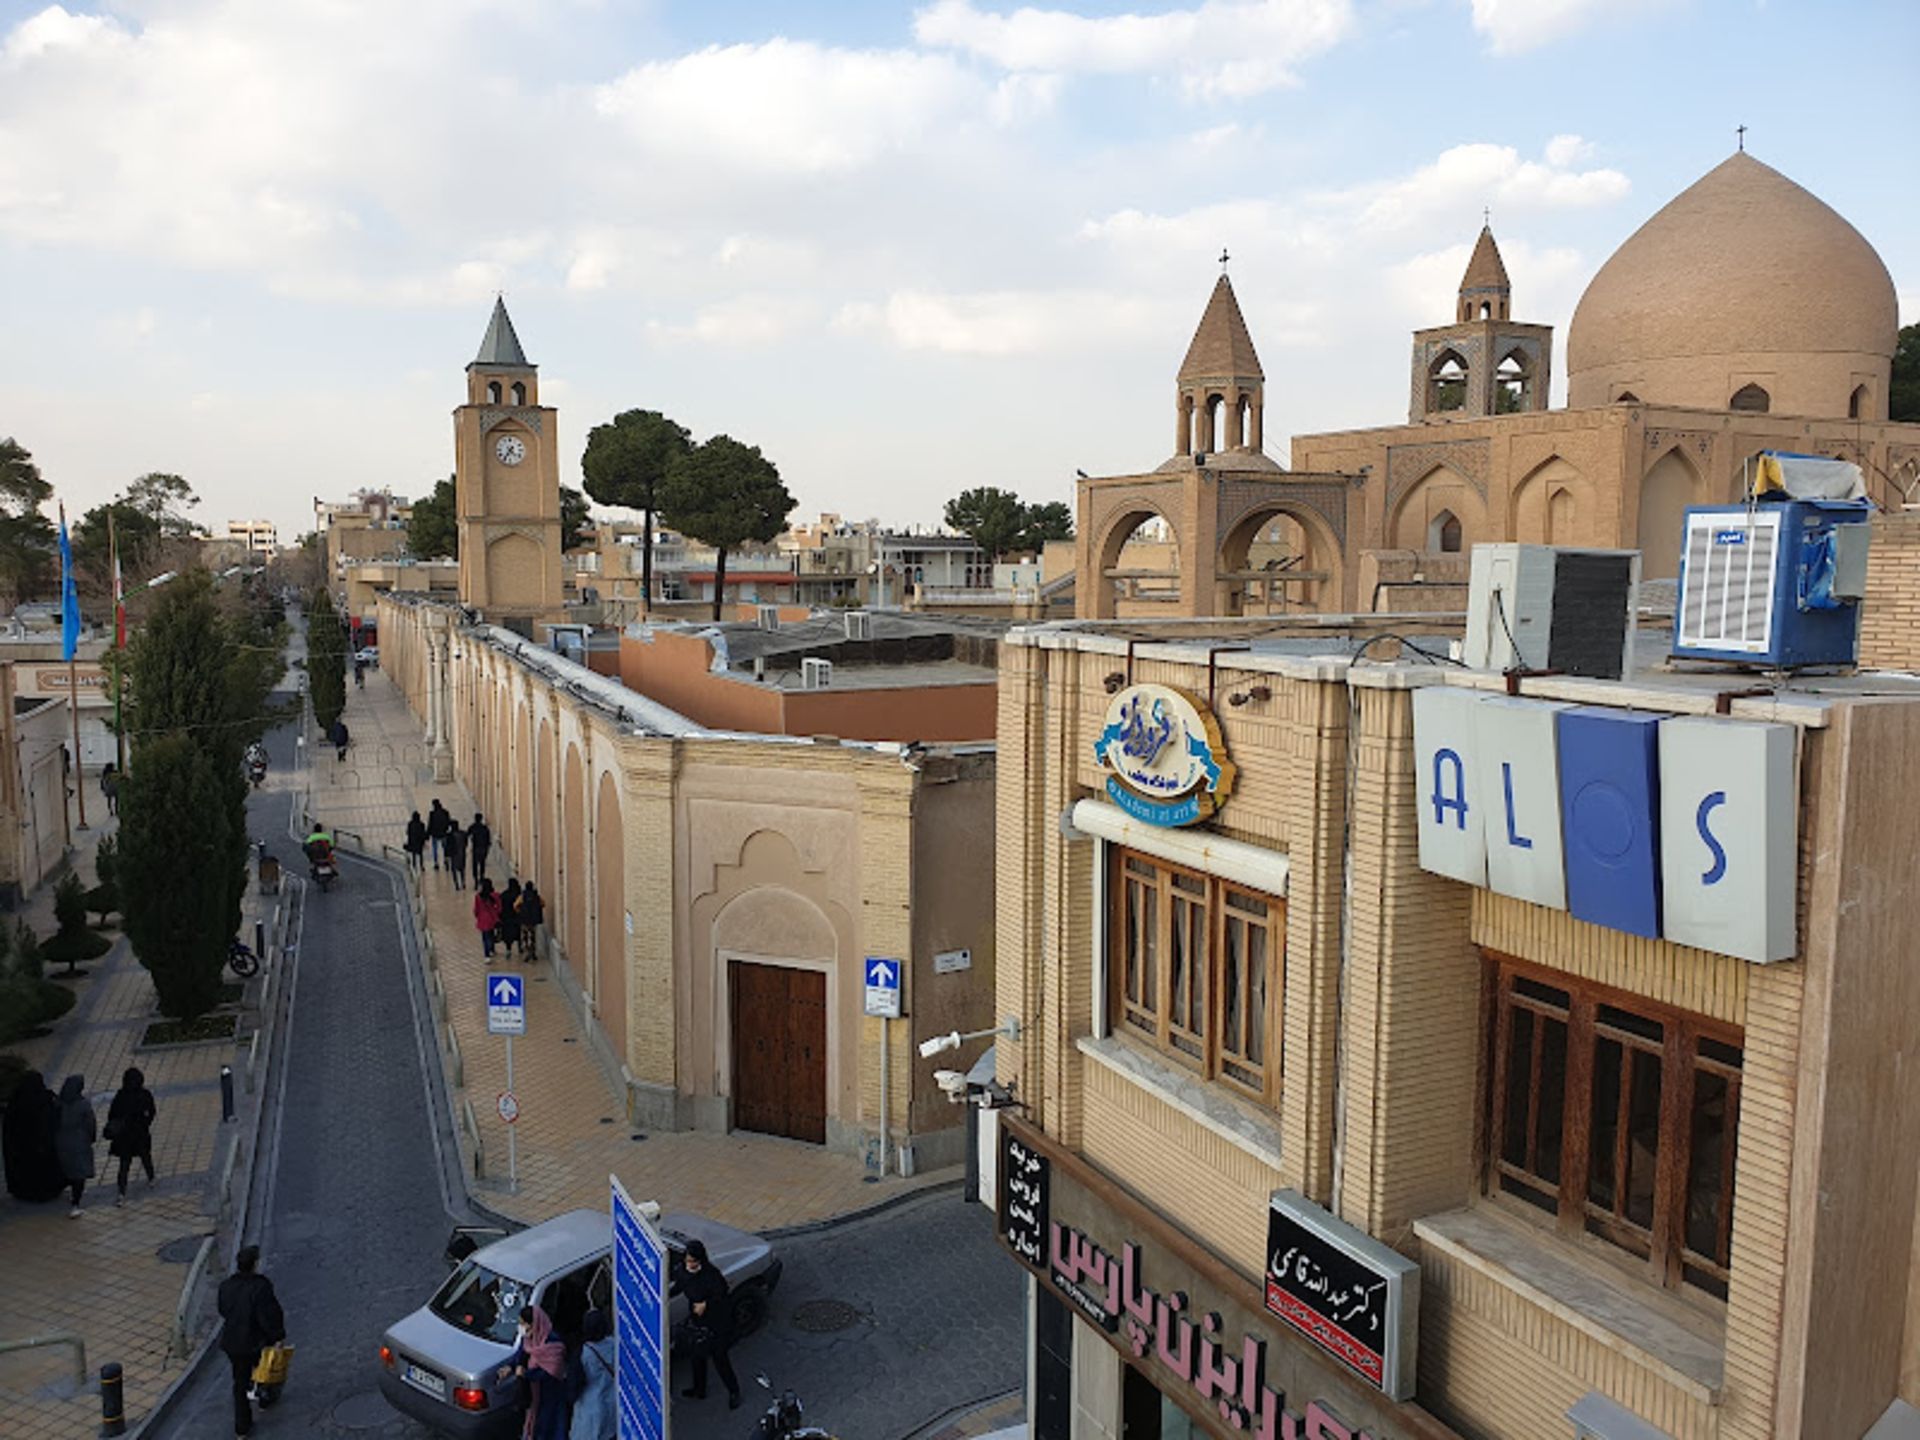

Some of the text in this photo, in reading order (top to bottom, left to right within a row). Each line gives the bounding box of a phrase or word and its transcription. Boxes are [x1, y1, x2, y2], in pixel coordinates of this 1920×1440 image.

[1009, 1141, 1041, 1172] خرید
[1009, 1171, 1040, 1206] فروش
[1009, 1199, 1040, 1237] رهن
[1008, 1227, 1040, 1263] اجاره
[1051, 1222, 1153, 1358] پارس
[1342, 1281, 1387, 1331] دکتر
